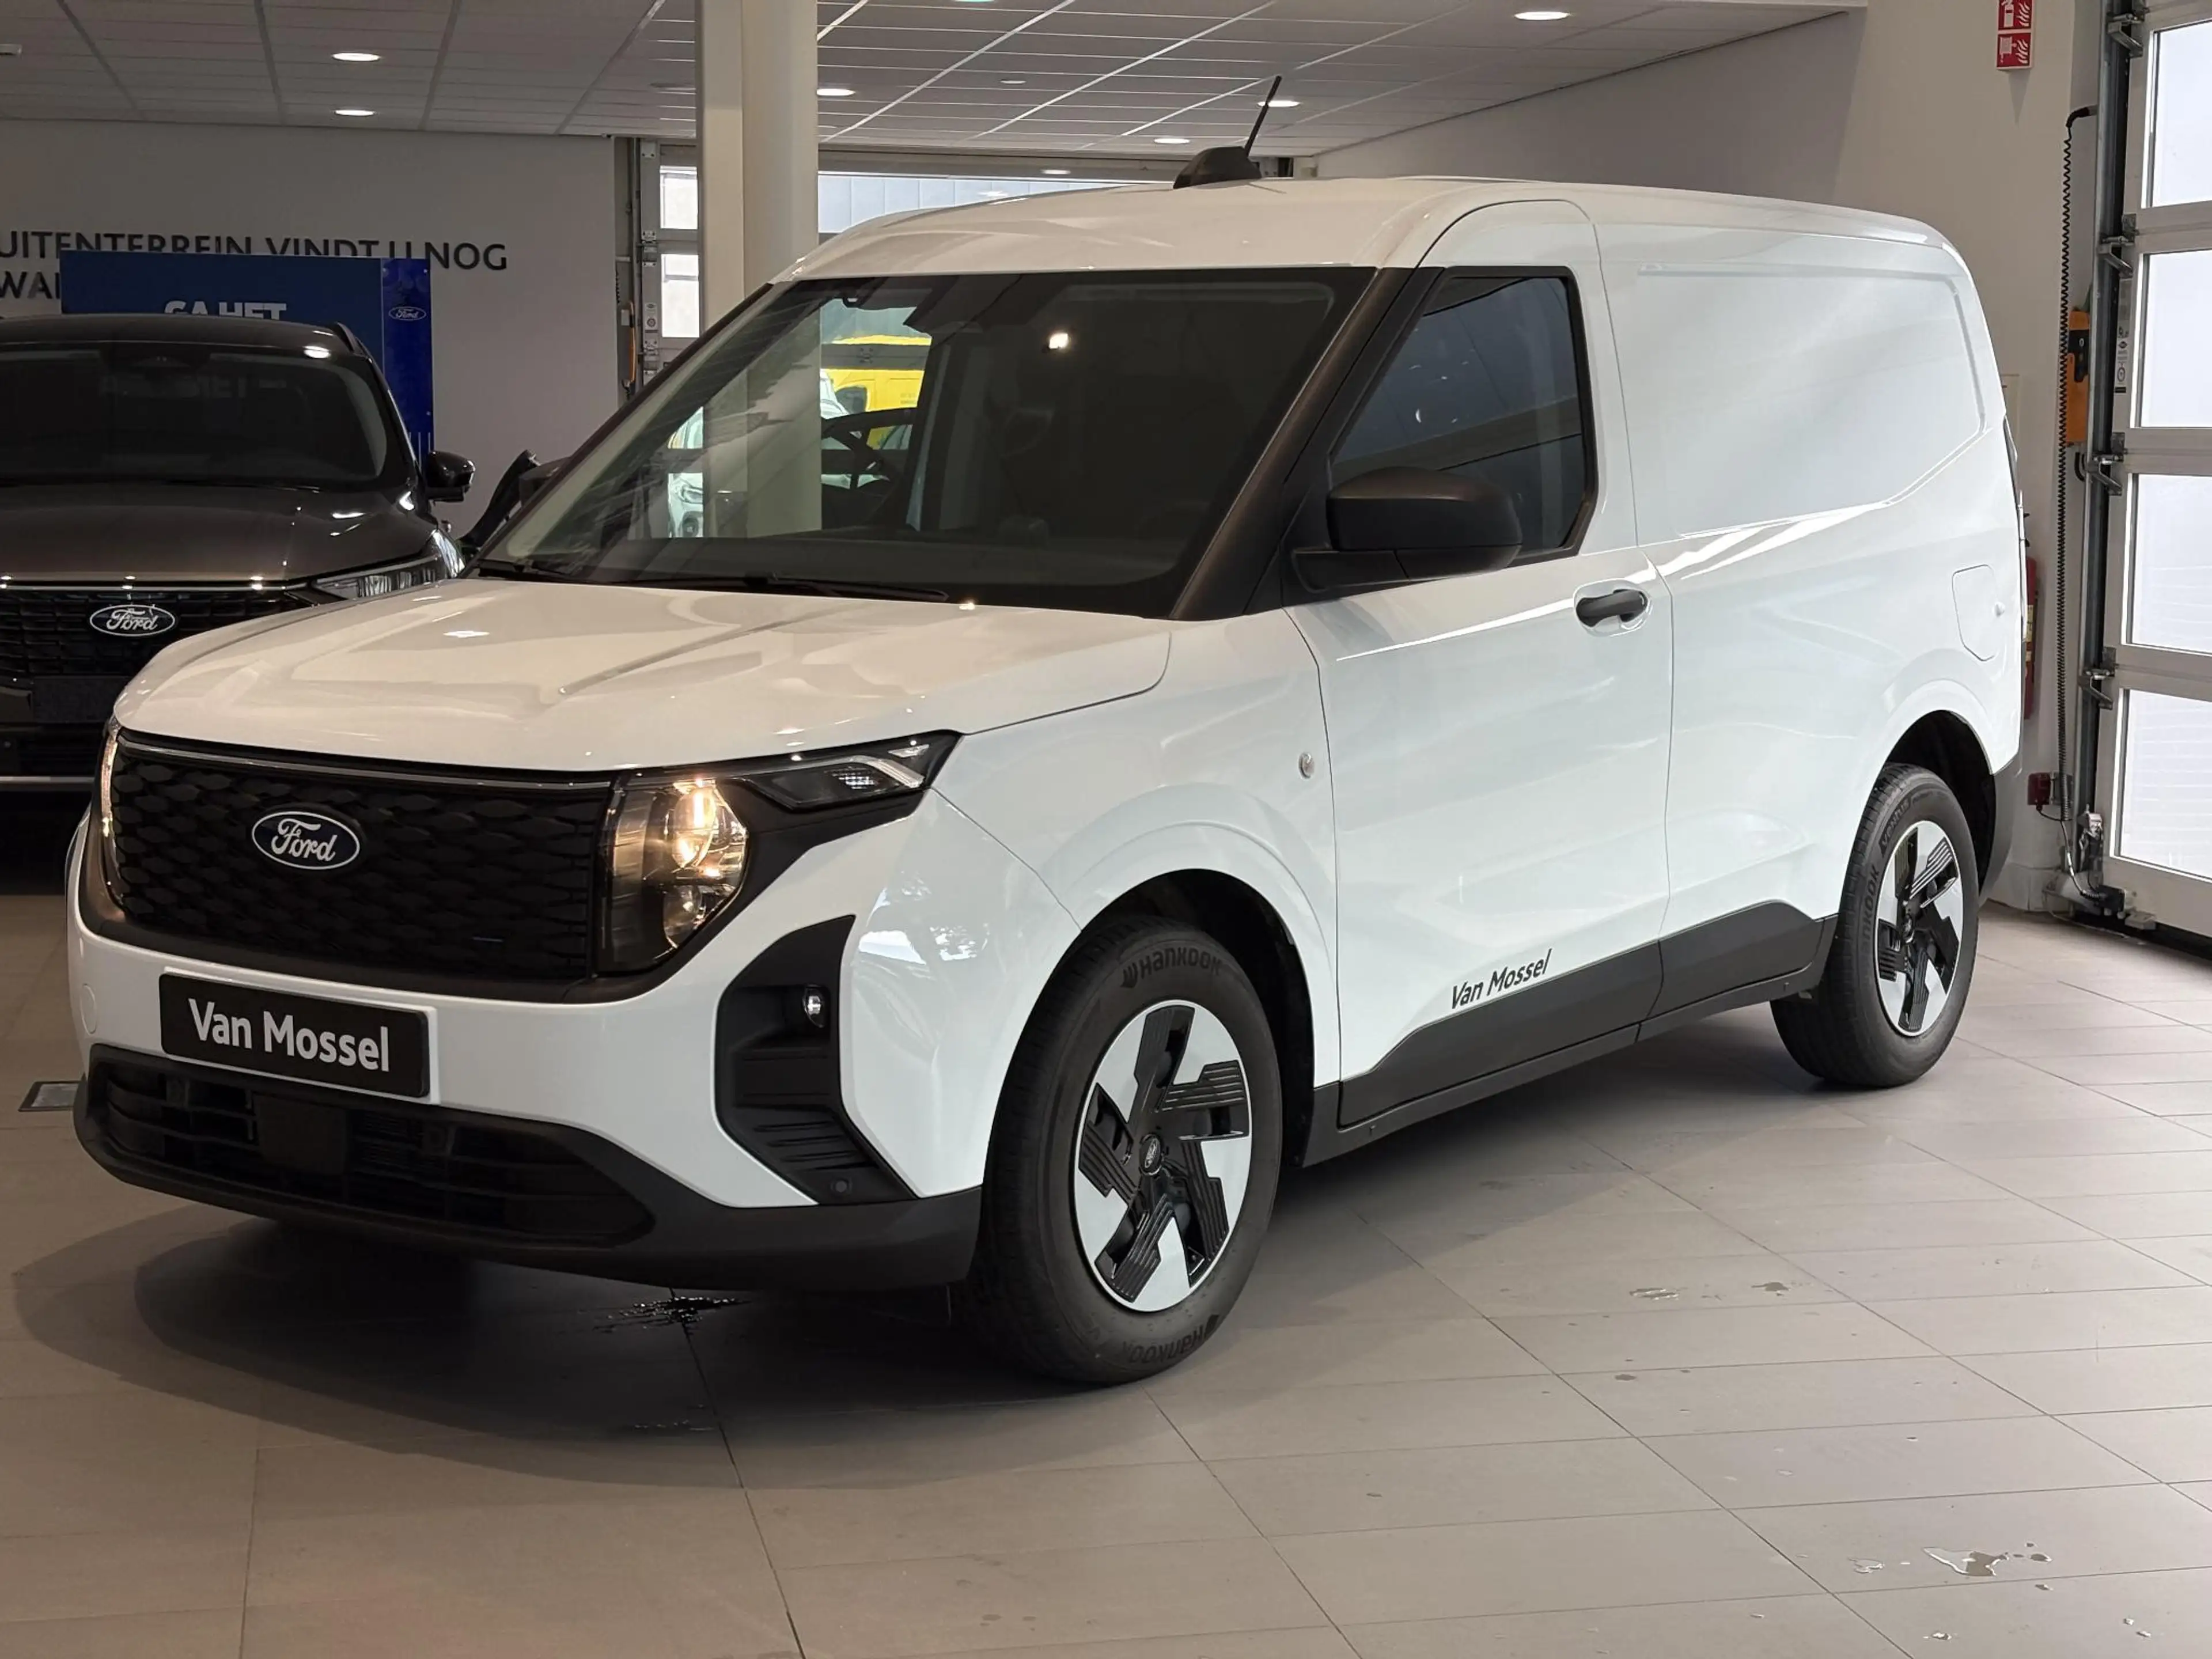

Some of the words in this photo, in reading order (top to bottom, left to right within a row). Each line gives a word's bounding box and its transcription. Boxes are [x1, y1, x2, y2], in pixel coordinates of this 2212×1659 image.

[425, 241, 507, 271] NOG
[106, 608, 158, 630] Ford
[271, 818, 338, 862] Ford
[1451, 980, 1484, 1009] Van
[1486, 948, 1552, 997] Mossel
[188, 998, 252, 1049] Van
[263, 1010, 390, 1072] Mossel
